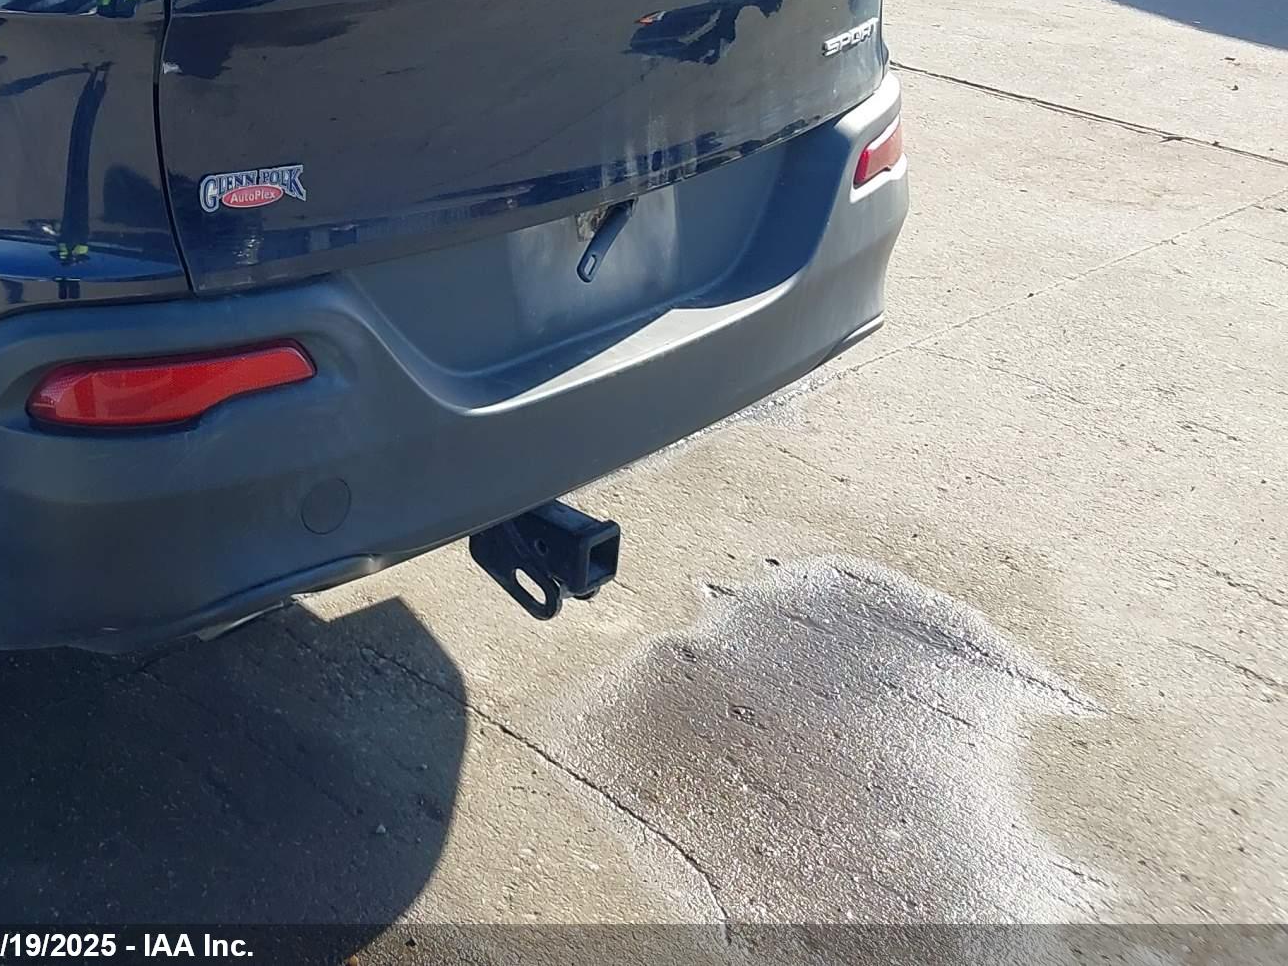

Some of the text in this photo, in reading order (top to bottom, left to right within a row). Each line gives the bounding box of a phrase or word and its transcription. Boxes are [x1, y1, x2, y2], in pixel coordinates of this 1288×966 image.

[822, 17, 880, 56] SPORT
[200, 169, 258, 212] GLENN
[229, 188, 276, 204] AutoPlex
